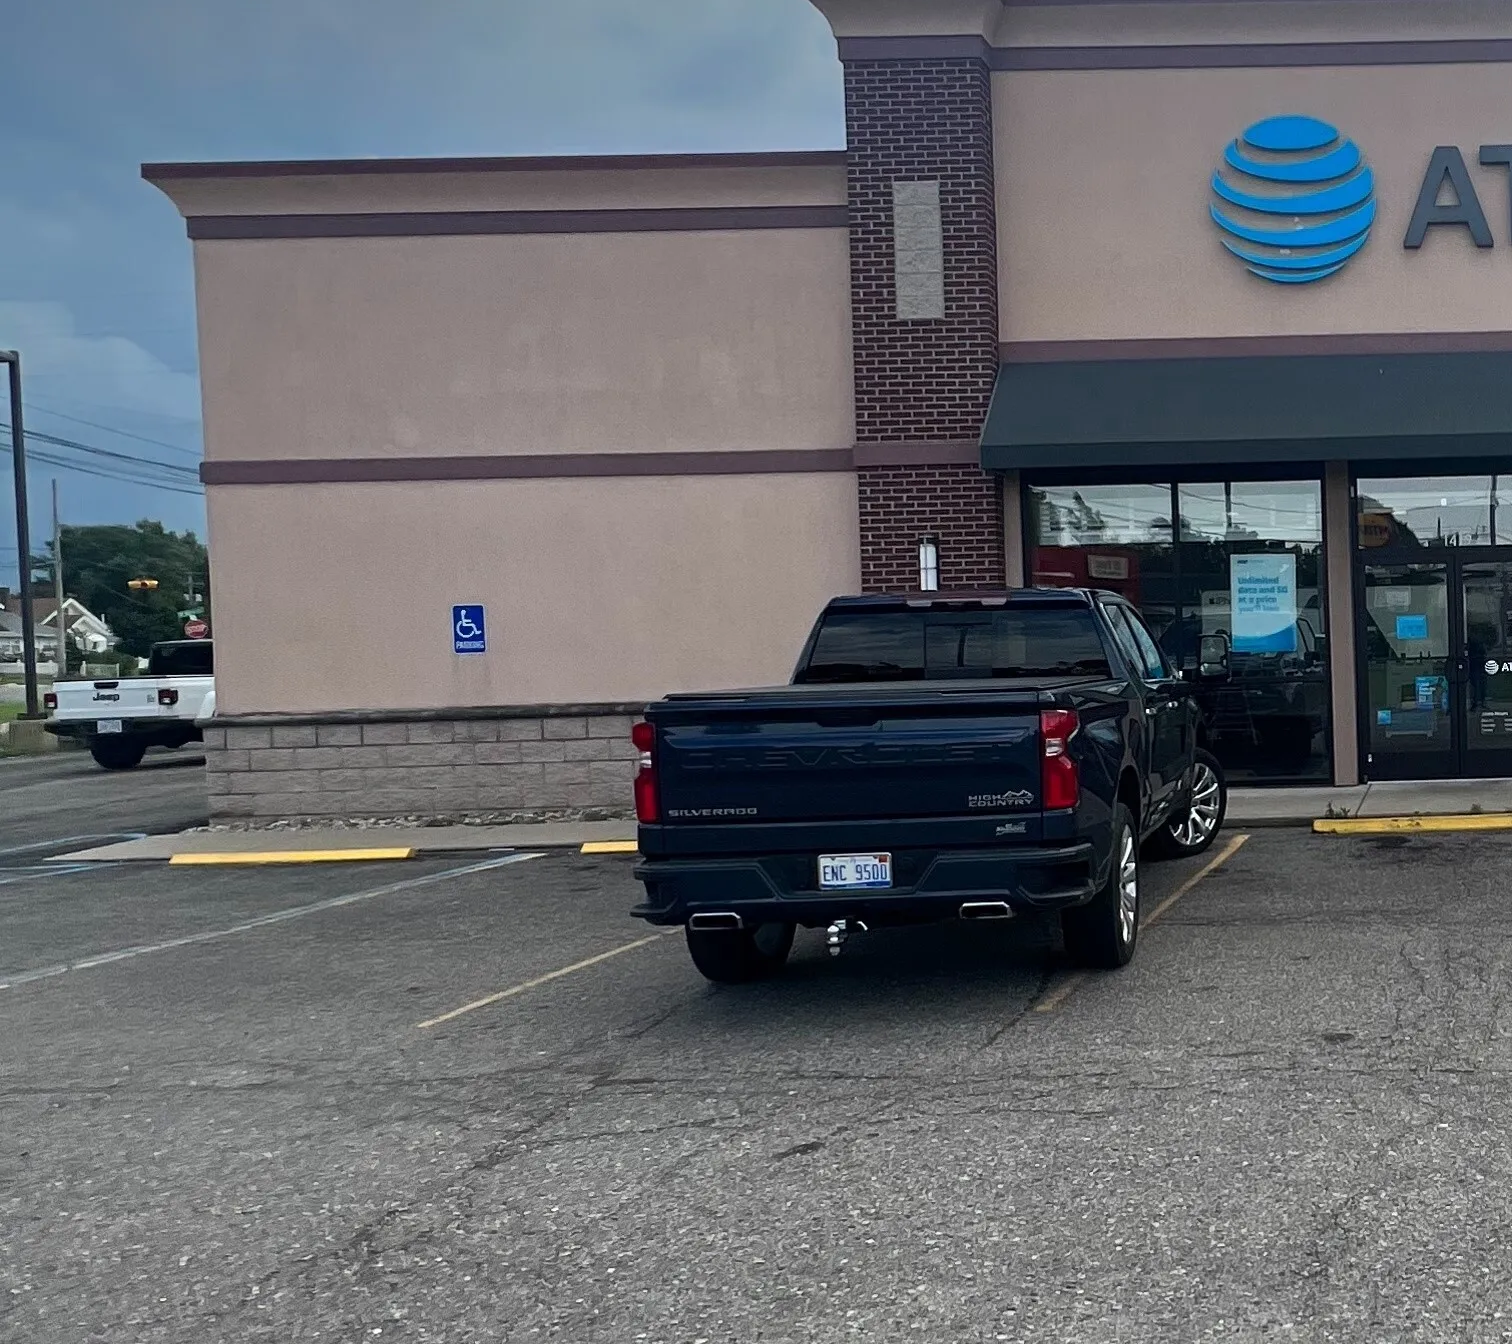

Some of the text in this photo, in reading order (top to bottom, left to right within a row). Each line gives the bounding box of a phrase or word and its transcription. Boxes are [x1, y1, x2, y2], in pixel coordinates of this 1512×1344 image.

[1237, 576, 1280, 585] Unlimited
[1259, 586, 1275, 594] and
[92, 692, 120, 702] Jeep
[968, 794, 1005, 802] HIGH
[968, 798, 1032, 808] COUNTRY
[668, 807, 758, 817] SILVERADO
[823, 863, 887, 882] ENC 9500
